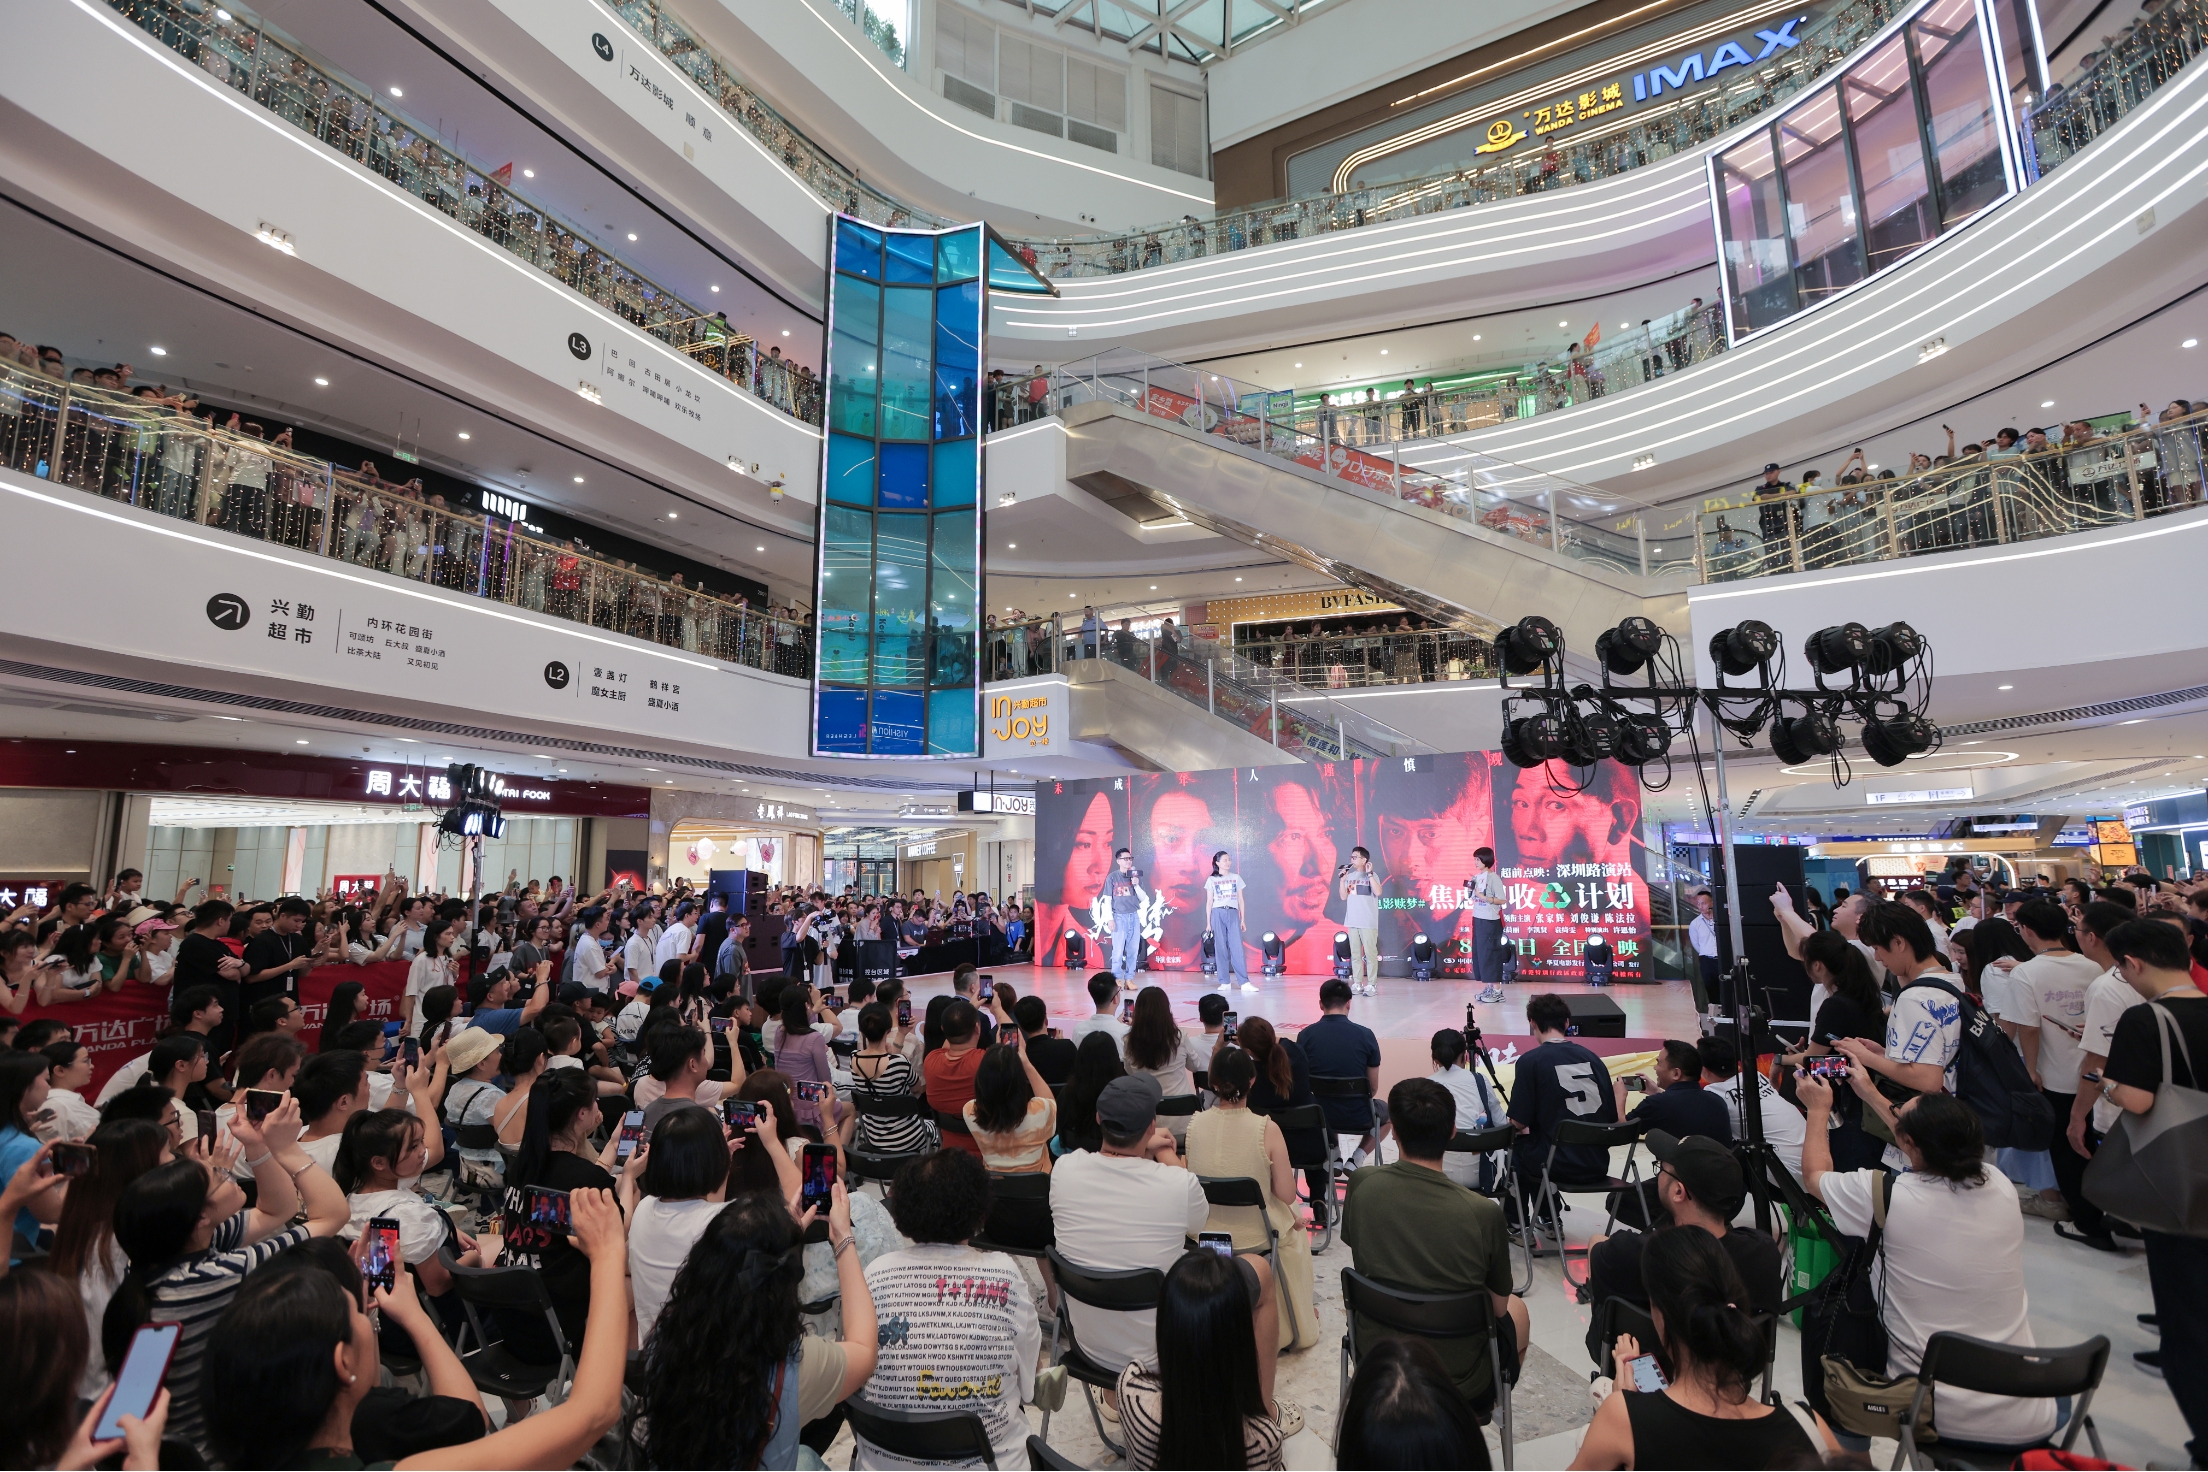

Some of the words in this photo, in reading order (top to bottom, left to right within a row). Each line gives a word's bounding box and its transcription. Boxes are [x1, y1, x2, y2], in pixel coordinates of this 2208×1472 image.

[595, 36, 610, 56] L4
[1632, 18, 1801, 101] IMAX
[629, 64, 674, 110] 万达影城
[1533, 82, 1622, 126] 万达影城
[1535, 117, 1574, 136] WANDA
[1578, 100, 1624, 121] CINEMA
[572, 337, 587, 354] L3
[270, 598, 315, 622] 兴勤
[267, 621, 313, 645] 超市
[367, 617, 433, 641] 内环花园街
[384, 638, 410, 652] 丘大叔
[347, 646, 382, 660] 比茶大陆
[407, 657, 439, 671] 又见初见
[548, 667, 565, 681] L2
[591, 685, 627, 702] 魔女主厨
[366, 770, 450, 800] 周大福
[522, 789, 551, 801] FOOK
[922, 842, 938, 856] COFFEE
[1556, 862, 1633, 879] 深圳路演站
[1575, 881, 1635, 911] 计划
[1535, 912, 1565, 924] 张家辉
[1570, 912, 1600, 924] 刘俊谦
[1604, 912, 1636, 925] 陈法拉
[85, 1041, 127, 1053] ANDA
[1554, 1061, 1603, 1117] 5
